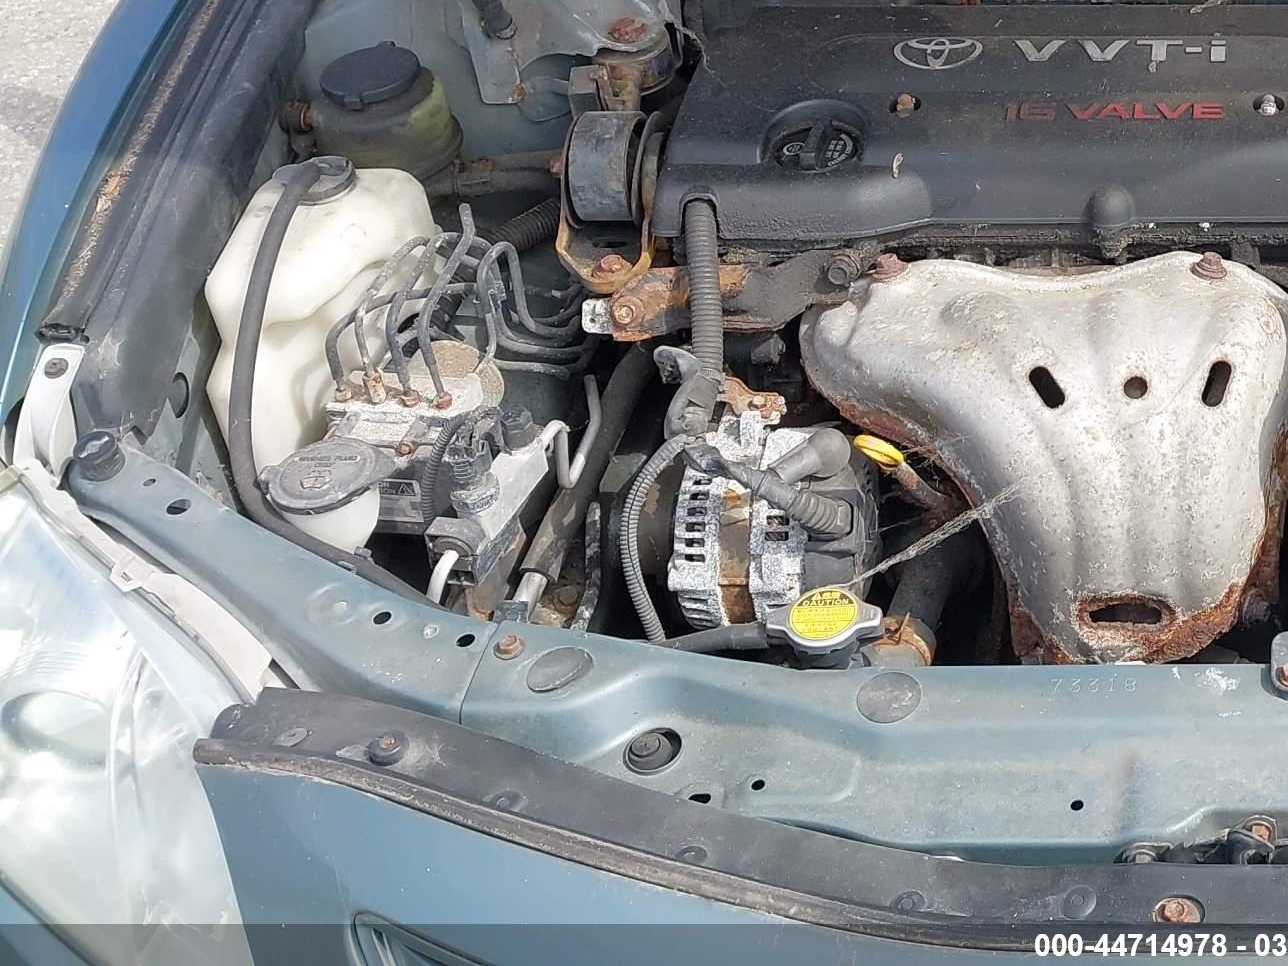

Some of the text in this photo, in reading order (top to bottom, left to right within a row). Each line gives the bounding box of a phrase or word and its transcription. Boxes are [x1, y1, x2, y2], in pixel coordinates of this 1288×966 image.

[1014, 37, 1227, 62] VVT-i
[1002, 101, 1226, 122] 16 VALVE
[802, 598, 849, 607] CAUTION
[1049, 677, 1138, 693] 73318
